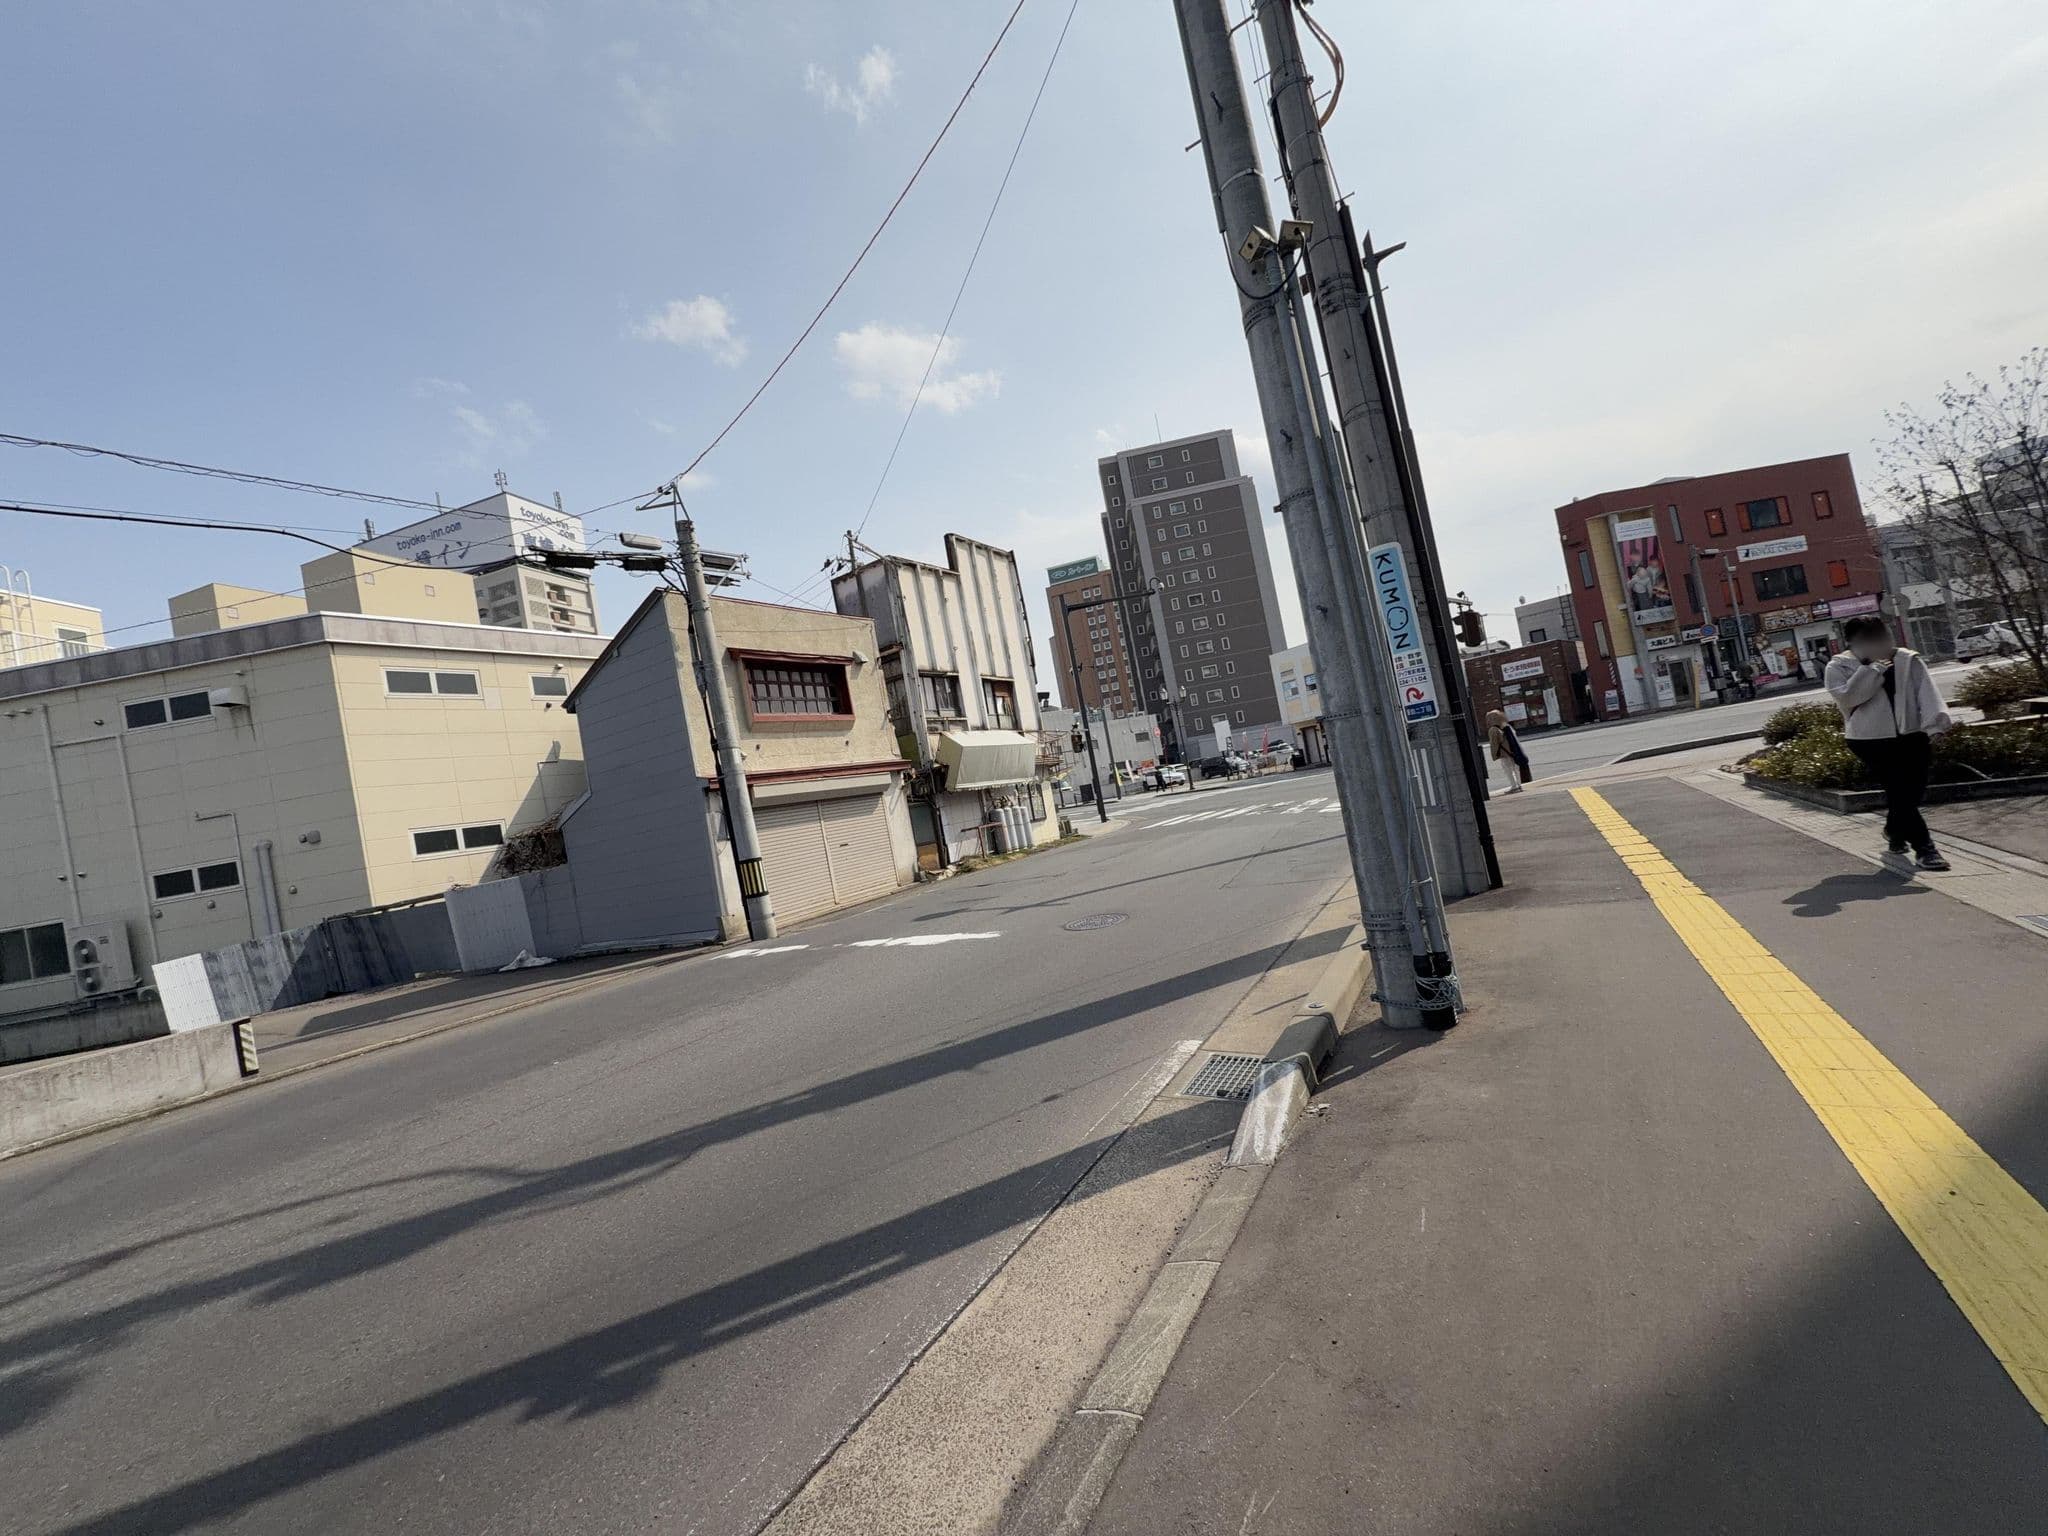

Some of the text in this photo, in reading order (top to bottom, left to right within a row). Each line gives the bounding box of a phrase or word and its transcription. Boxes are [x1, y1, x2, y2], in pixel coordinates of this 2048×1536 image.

[519, 506, 569, 531] toyoko-inn
[397, 521, 462, 550] toyoko-inn.com
[1375, 552, 1411, 650] KUMON
